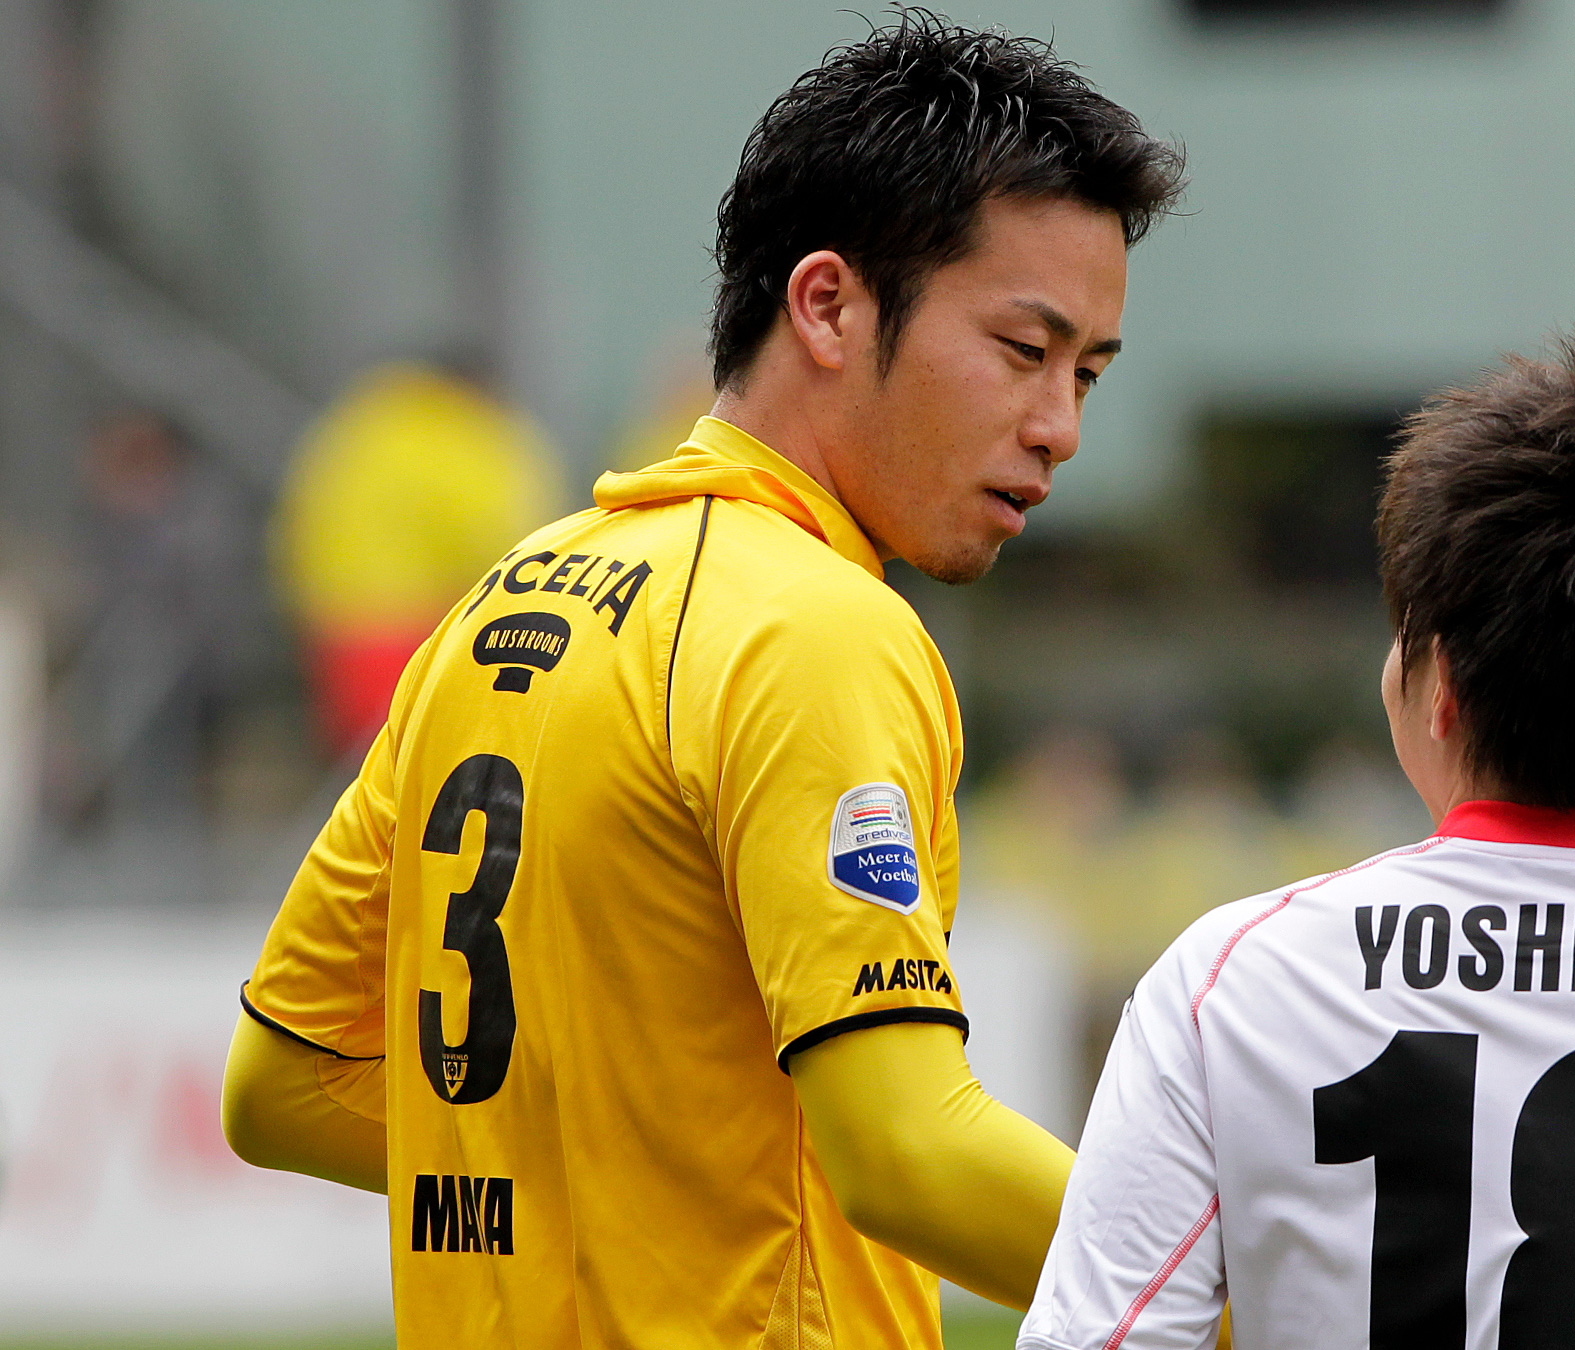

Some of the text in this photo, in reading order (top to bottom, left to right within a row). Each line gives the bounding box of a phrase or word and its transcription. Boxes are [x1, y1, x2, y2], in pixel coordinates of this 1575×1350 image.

[485, 630, 565, 657] MUSHROOMS
[858, 852, 900, 869] Meer
[418, 753, 524, 1105] 3
[852, 959, 952, 997] MASITA
